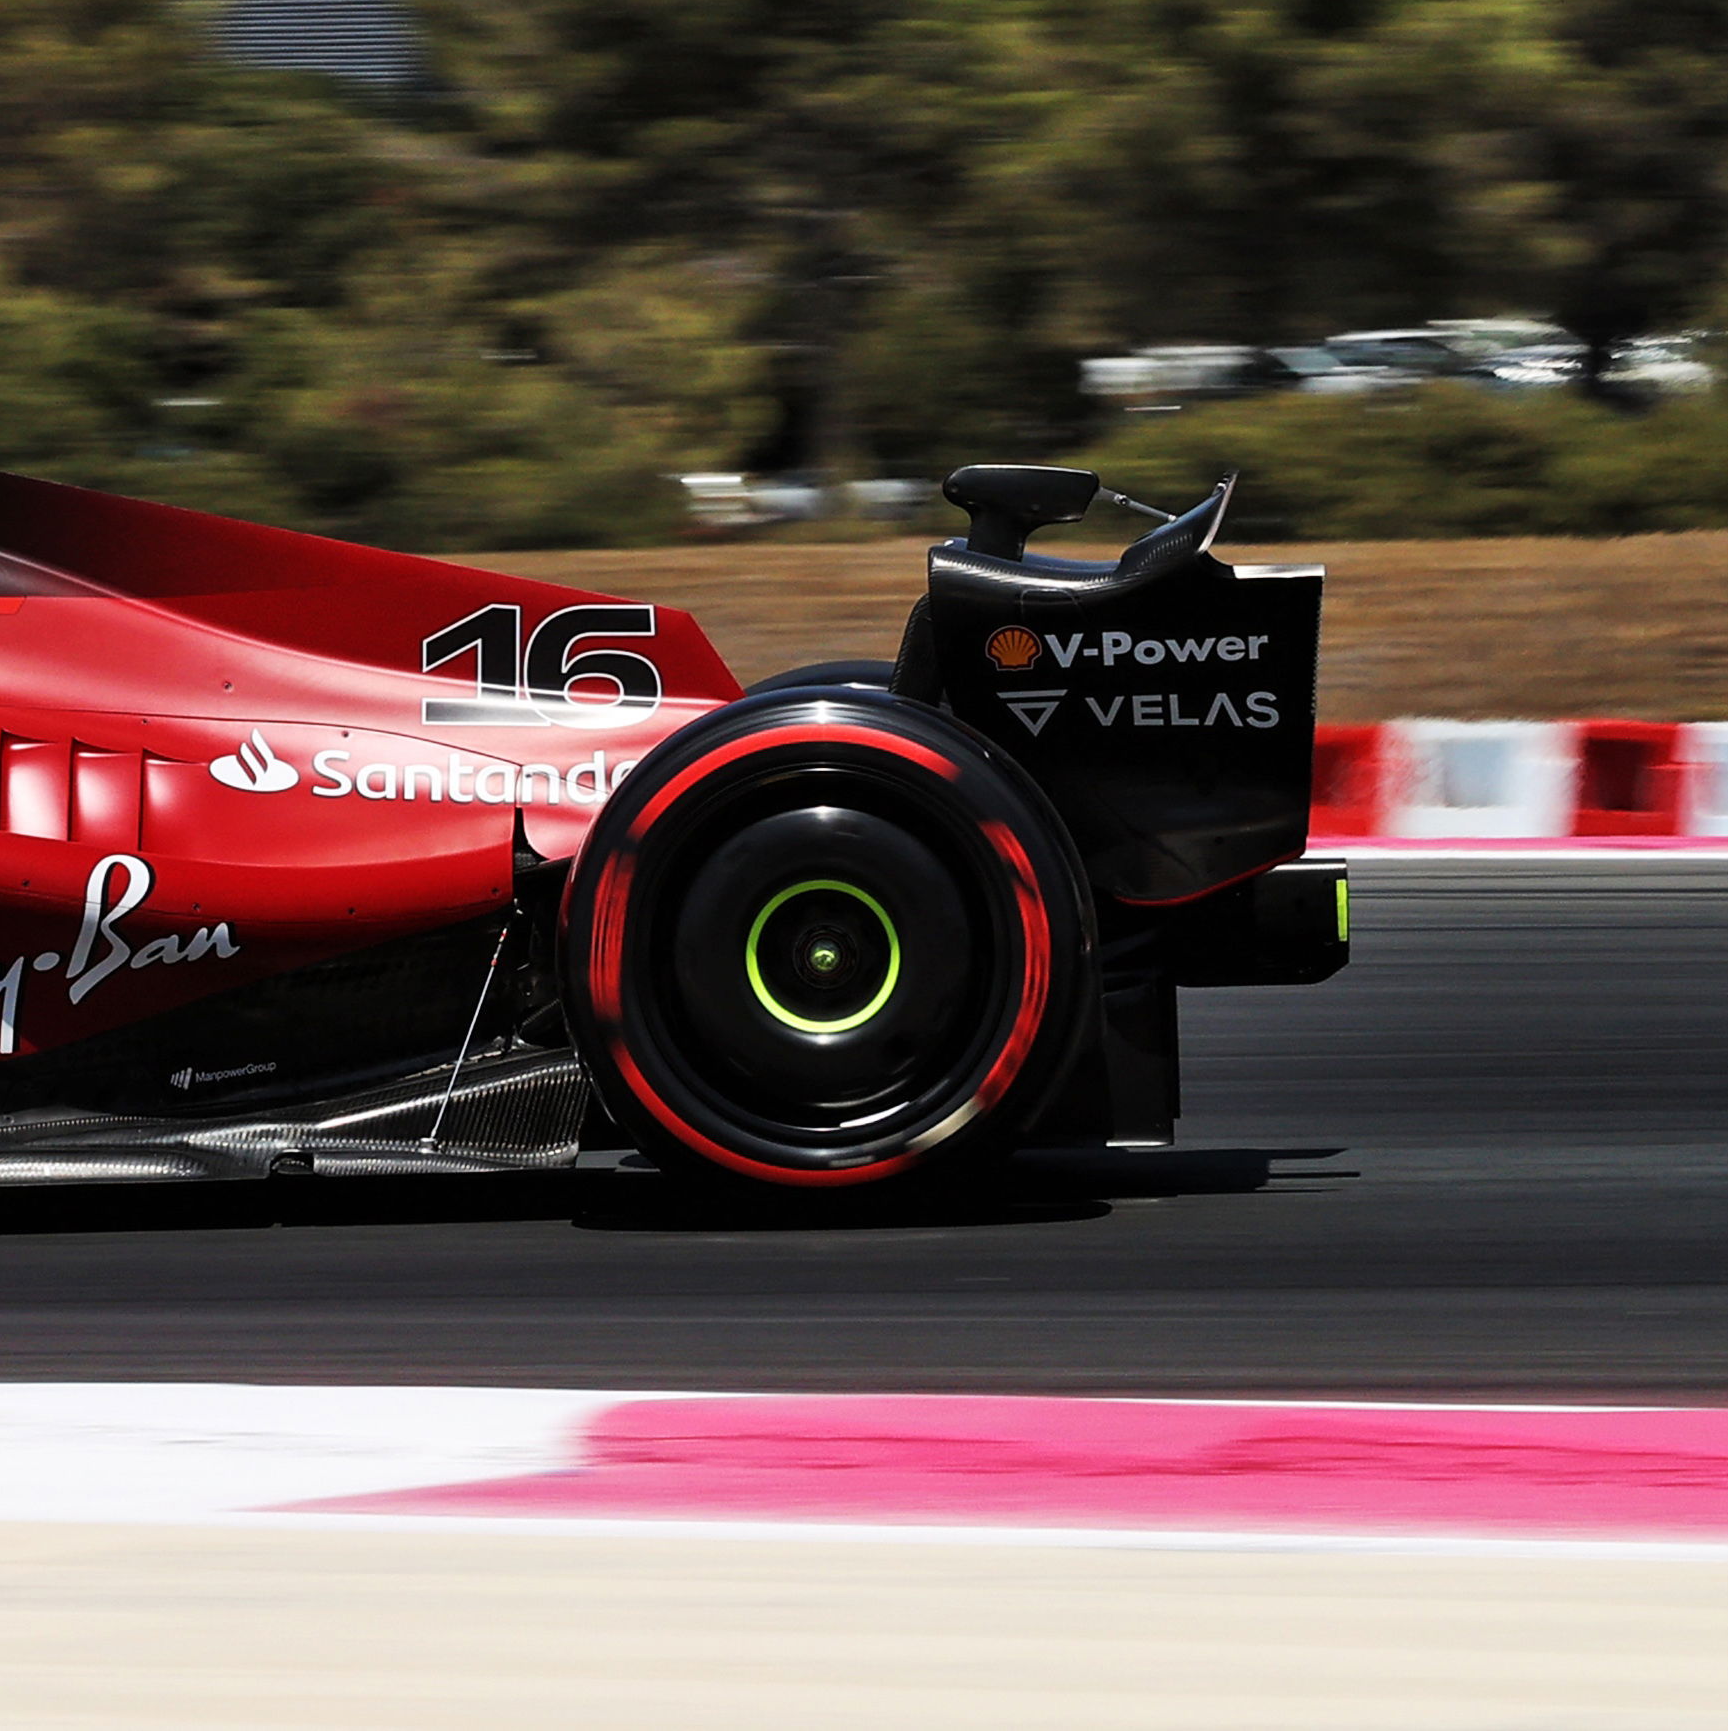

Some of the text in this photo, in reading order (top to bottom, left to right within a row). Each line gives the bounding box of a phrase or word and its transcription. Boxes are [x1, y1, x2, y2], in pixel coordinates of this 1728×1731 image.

[422, 603, 661, 730] 16
[1044, 631, 1269, 668] V-Power
[1085, 691, 1280, 729] VELAS
[195, 1061, 277, 1083] ManpowerGroup
